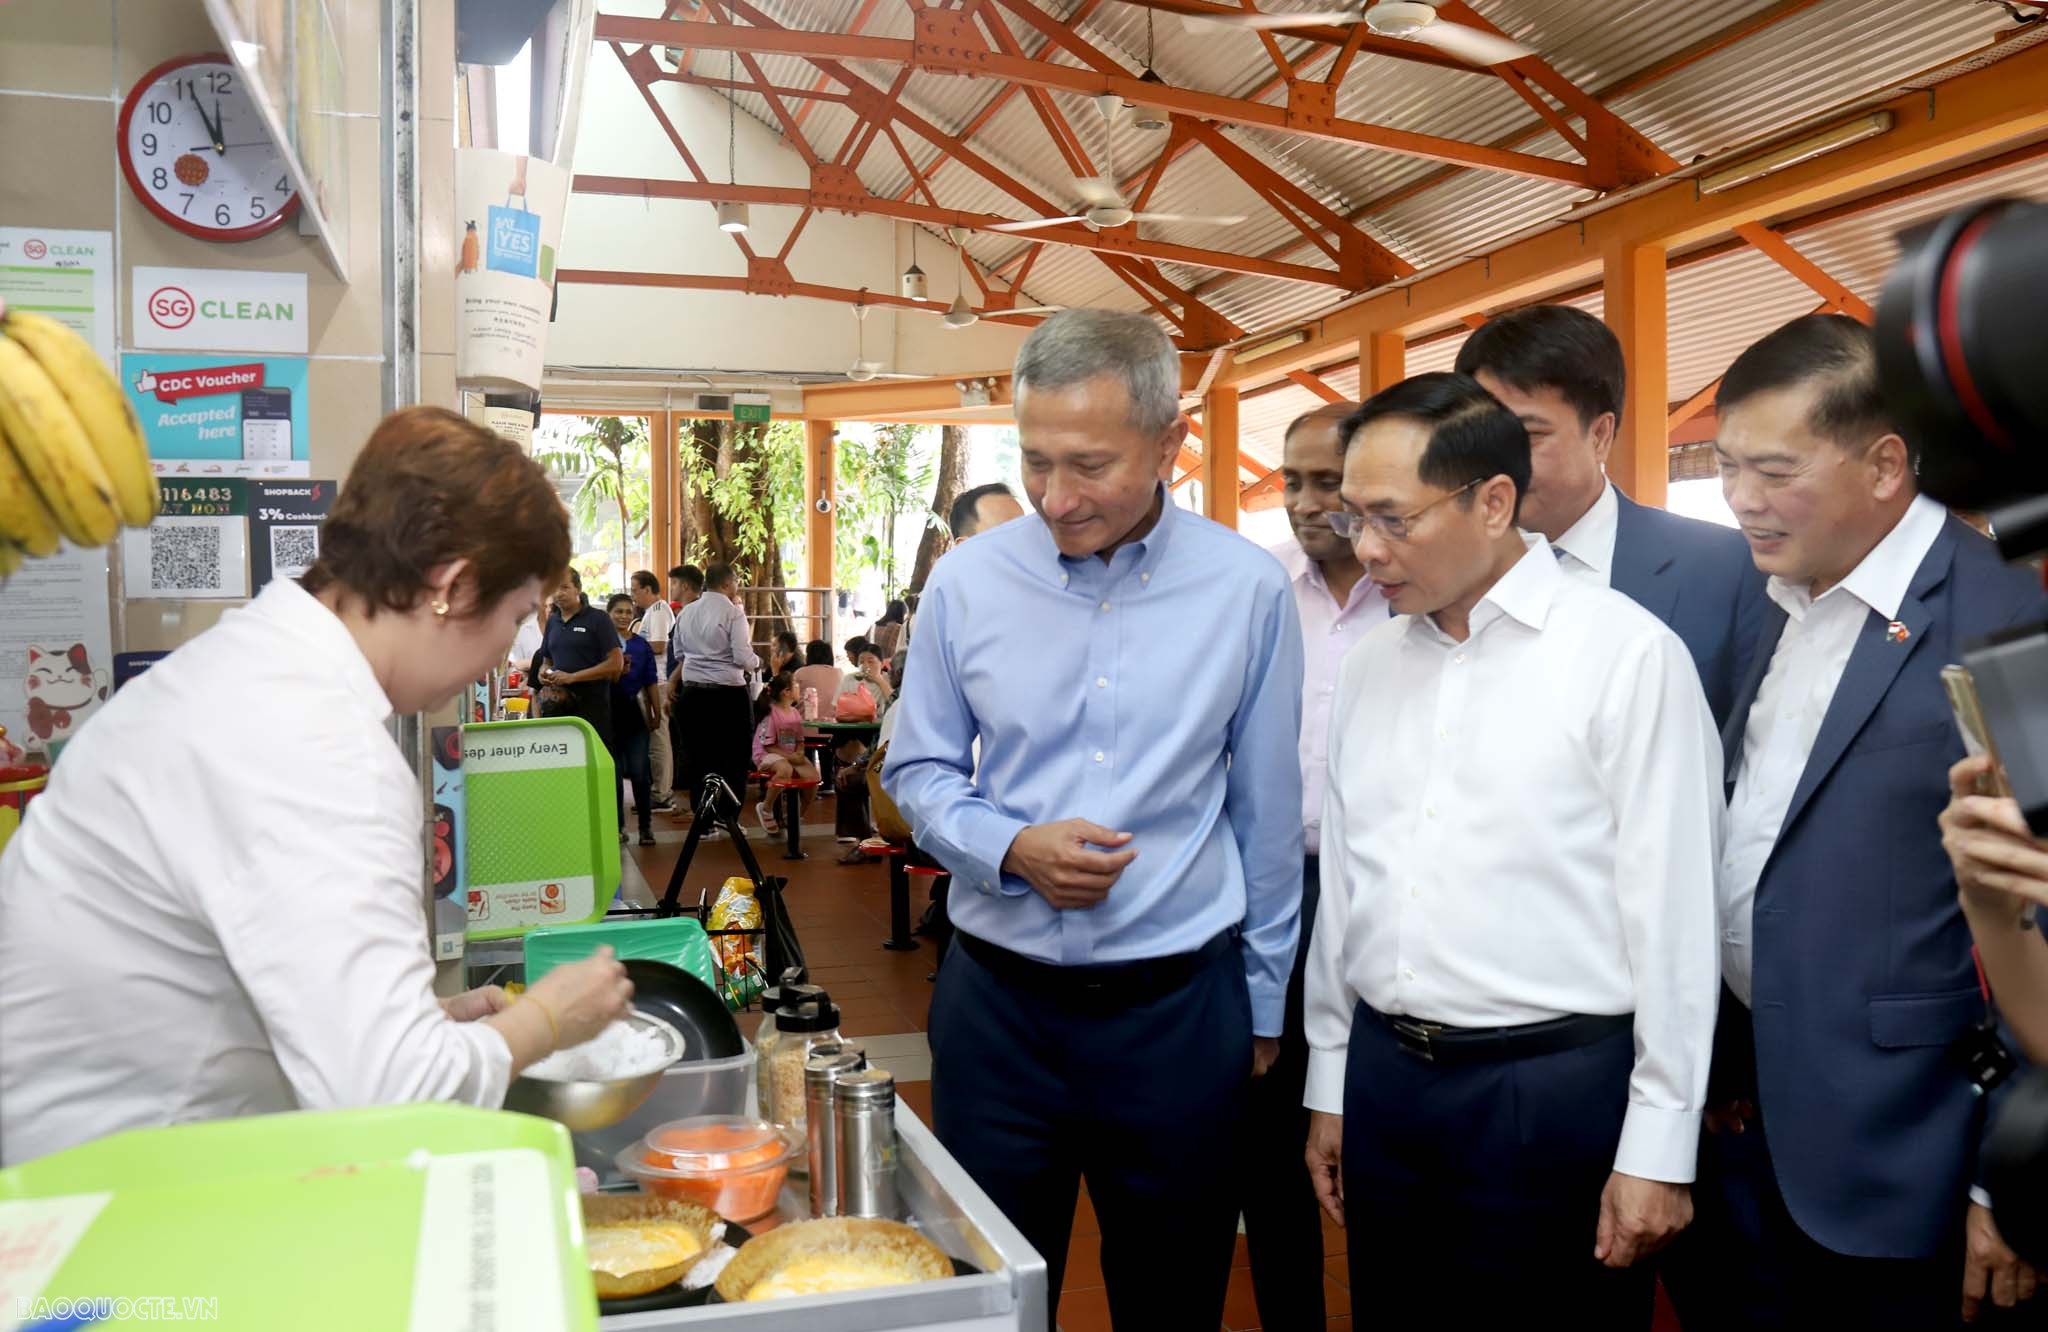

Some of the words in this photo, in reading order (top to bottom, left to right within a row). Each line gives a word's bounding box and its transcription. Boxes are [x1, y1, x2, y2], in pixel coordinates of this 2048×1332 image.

[207, 72, 232, 94] 12
[147, 102, 172, 124] 10
[142, 133, 158, 156] 9
[152, 167, 168, 190] 8
[274, 175, 291, 196] 4
[179, 193, 195, 215] 7
[215, 204, 231, 226] 6
[250, 197, 266, 219] 5
[49, 245, 95, 256] CLEAN
[497, 231, 531, 253] YES
[155, 299, 189, 317] SG
[200, 300, 294, 321] CLEAN
[159, 377, 192, 393] CDC
[195, 371, 257, 389] Voucher
[157, 405, 236, 428] Accepted
[198, 426, 237, 441] here
[159, 487, 233, 501] 116483
[263, 488, 312, 496] SHOPBACK
[258, 508, 285, 521] 3%
[490, 745, 525, 758] diner
[529, 742, 568, 754] Every
